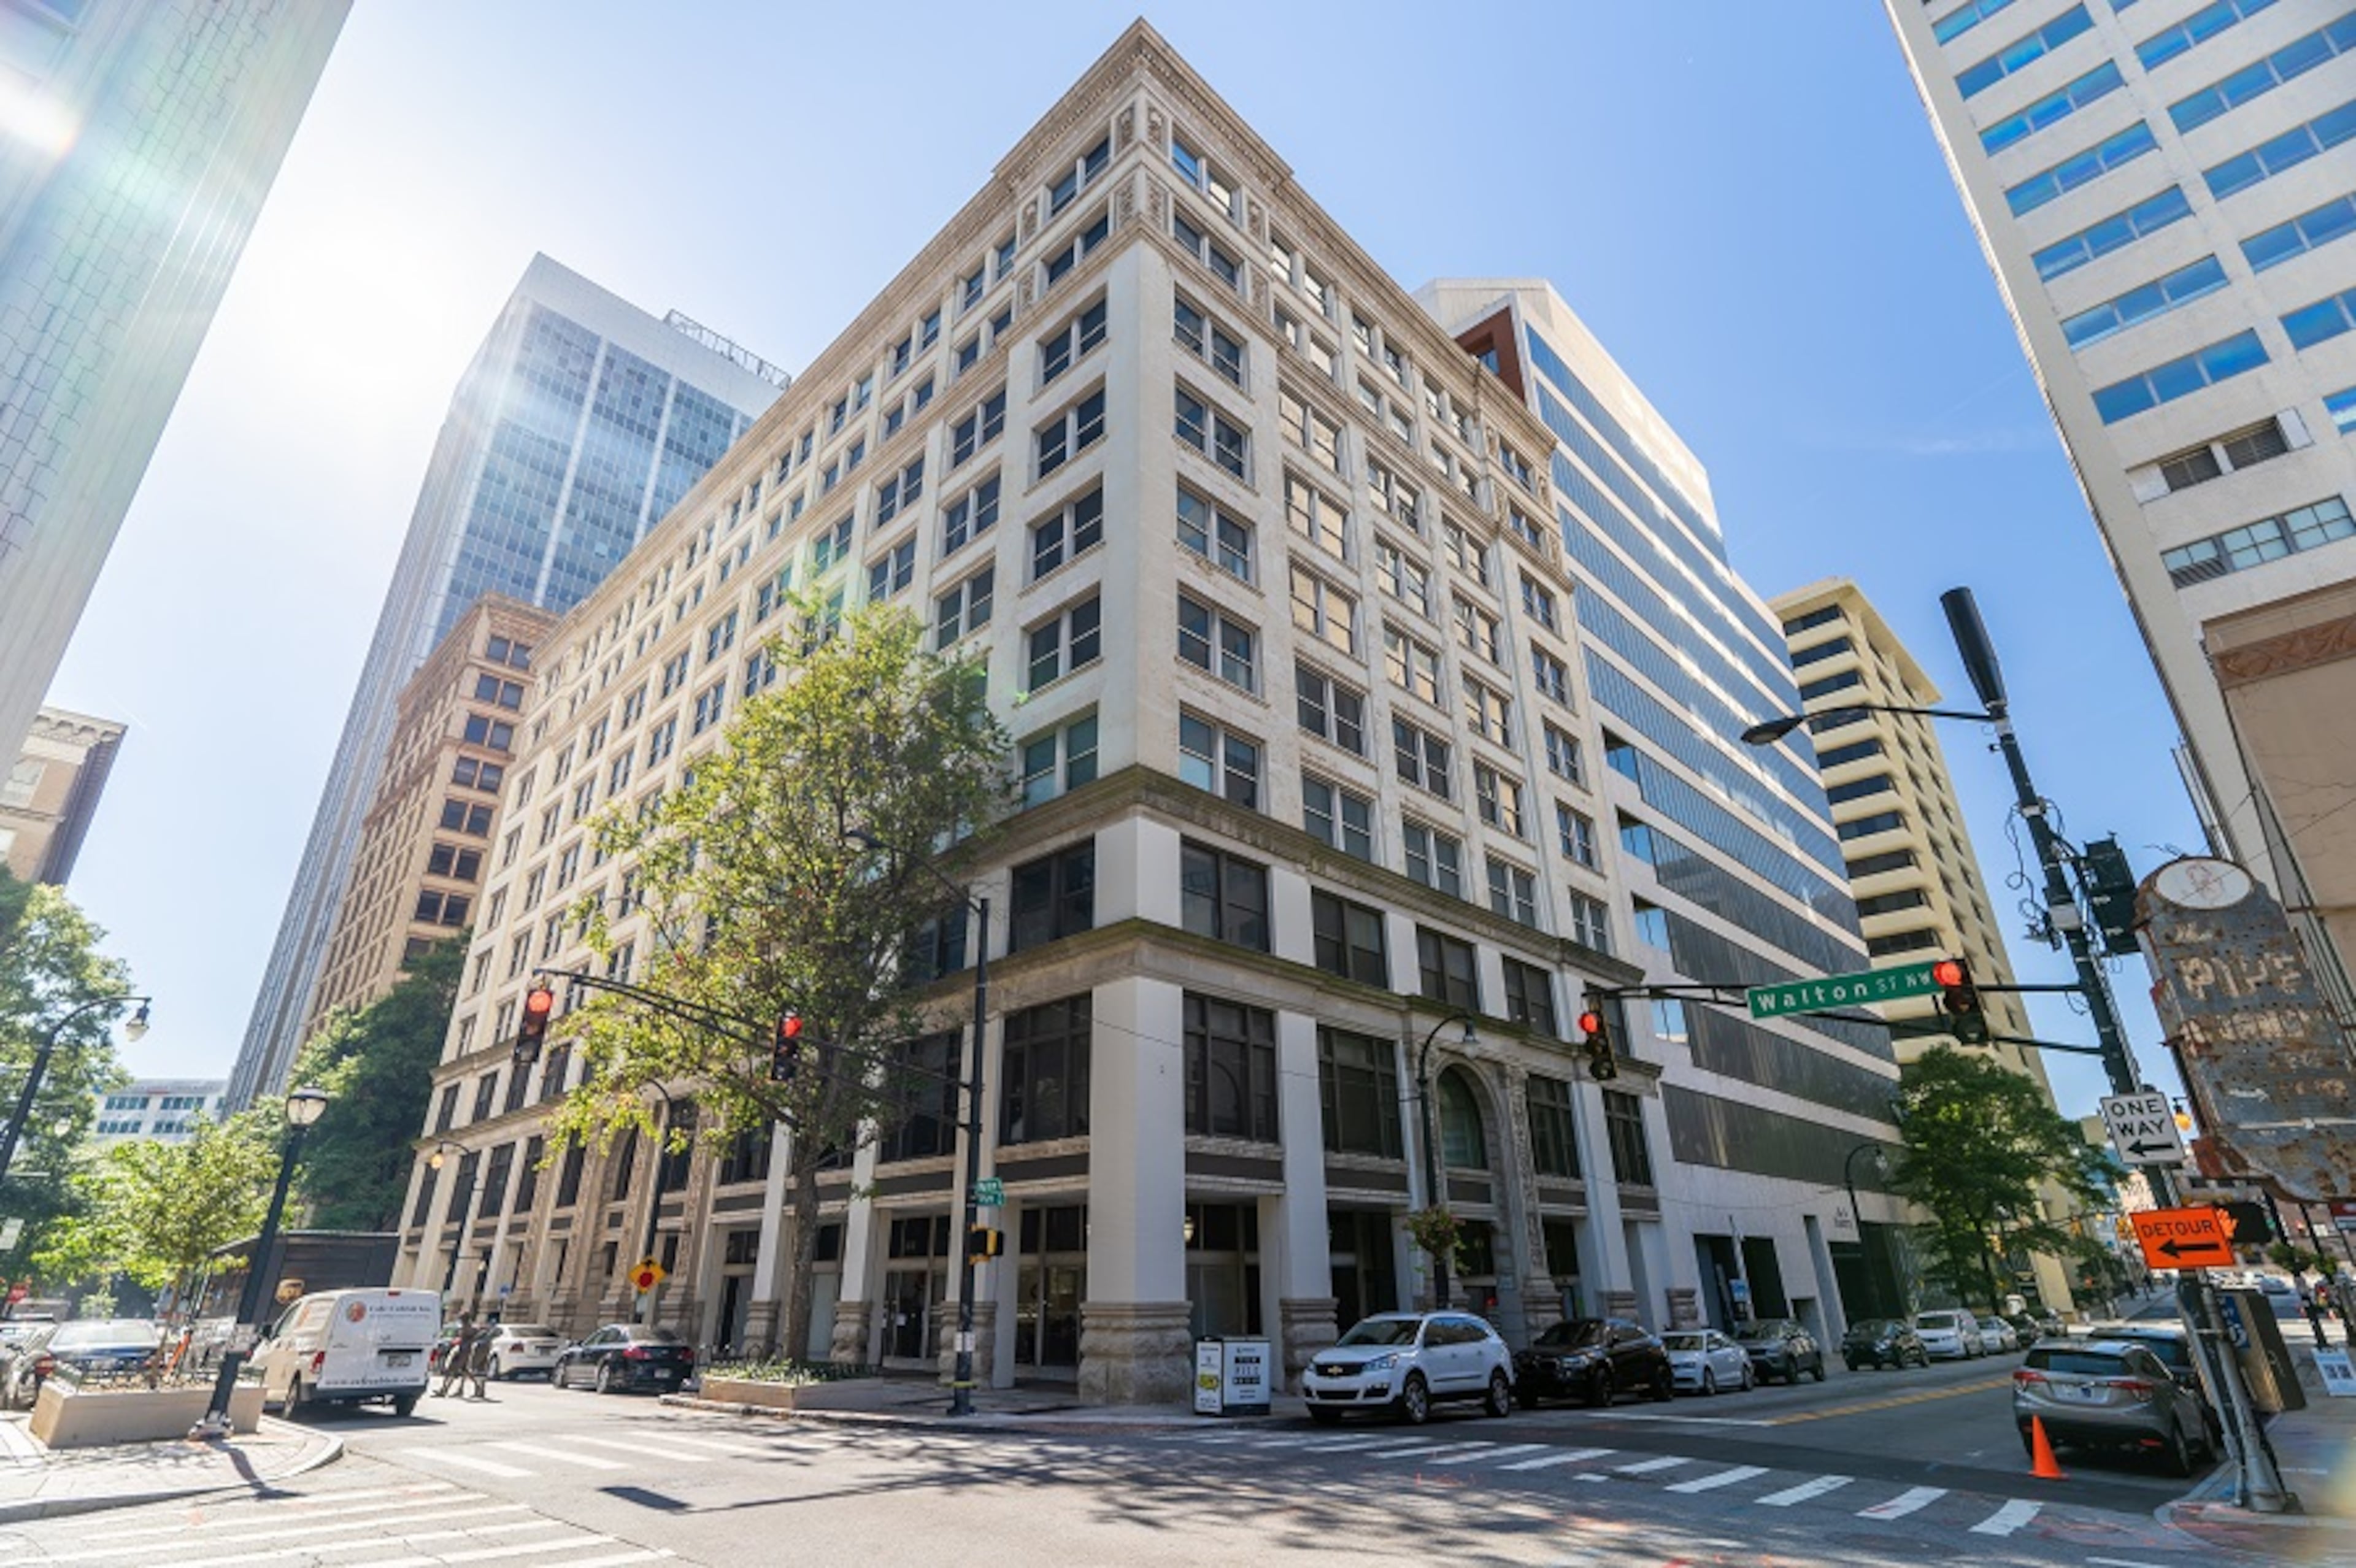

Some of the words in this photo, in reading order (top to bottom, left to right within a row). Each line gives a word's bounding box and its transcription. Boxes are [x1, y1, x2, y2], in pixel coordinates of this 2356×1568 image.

[1757, 982, 1868, 1011] Walton
[1876, 976, 1896, 993] ST
[1905, 970, 1931, 988] NW
[2111, 1099, 2163, 1116] ONE
[2115, 1118, 2165, 1136] WAY
[2141, 1220, 2215, 1237] DETOUR
